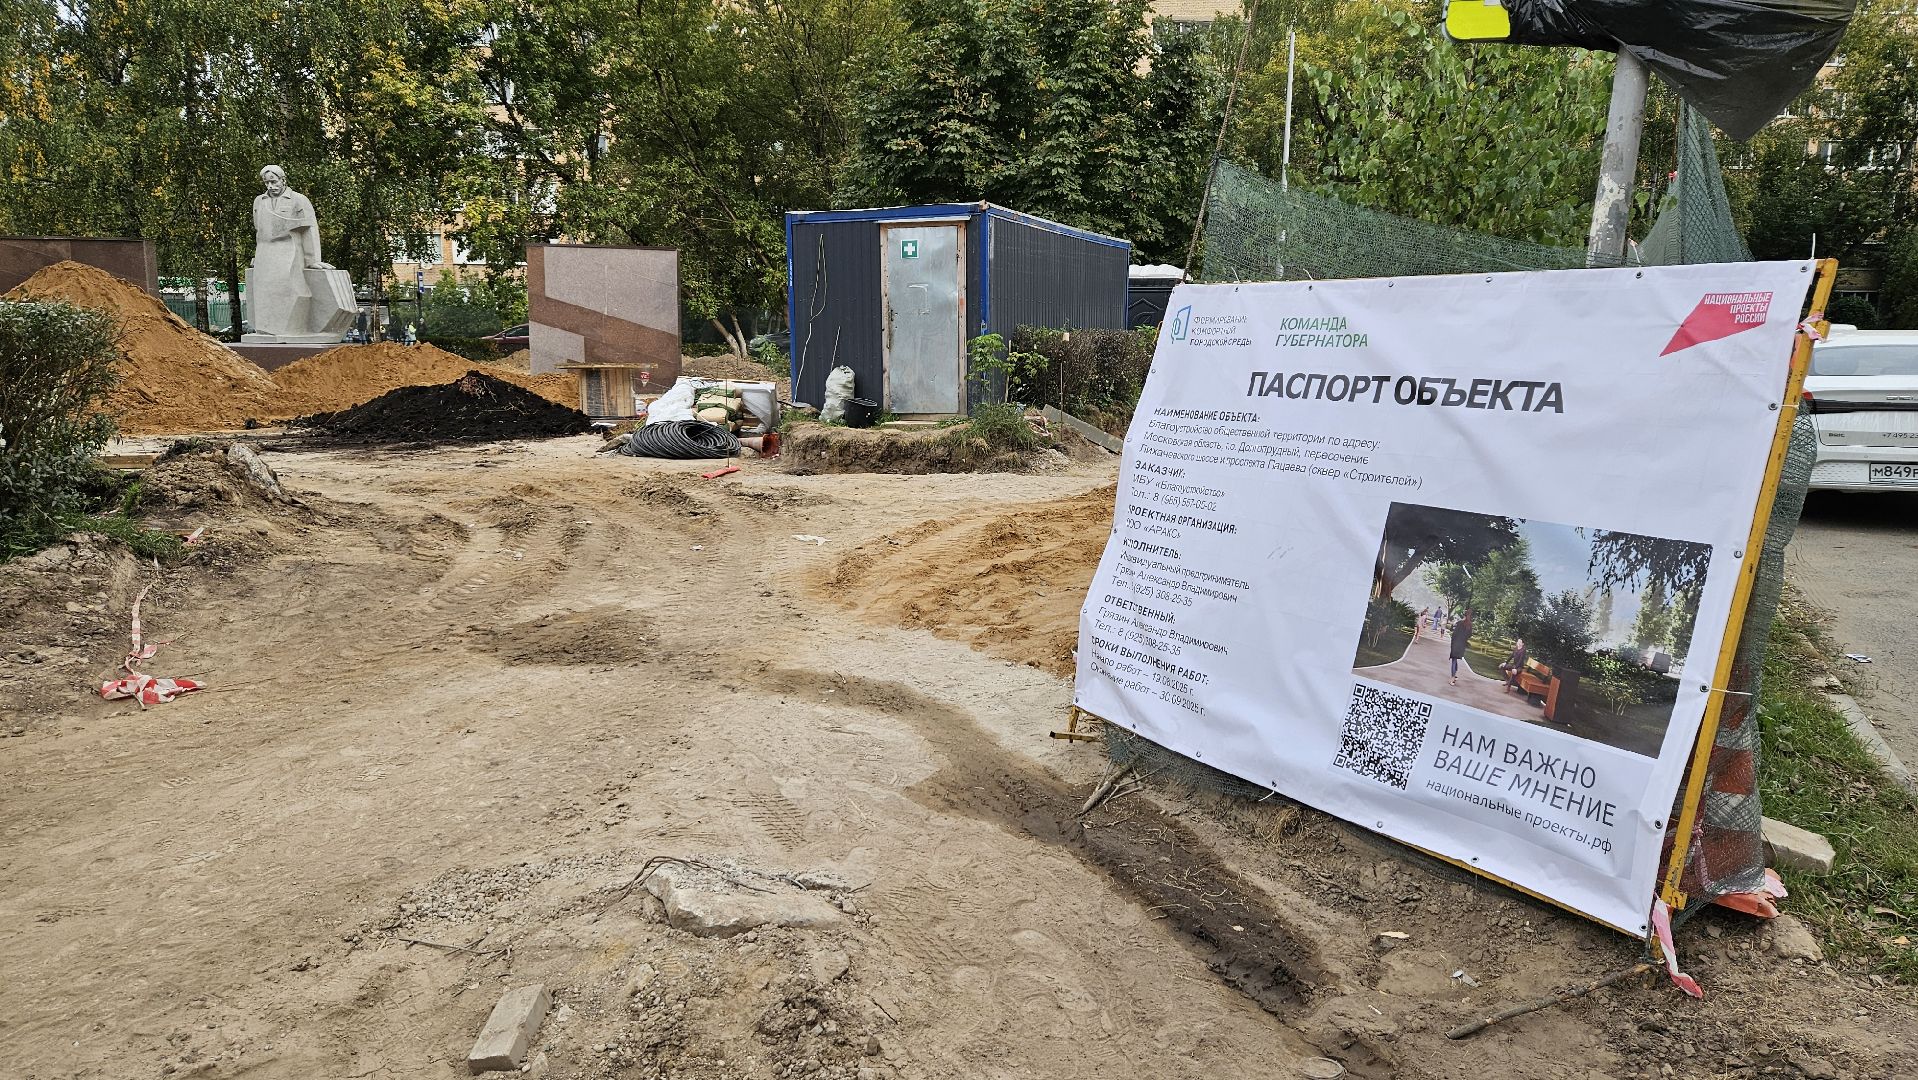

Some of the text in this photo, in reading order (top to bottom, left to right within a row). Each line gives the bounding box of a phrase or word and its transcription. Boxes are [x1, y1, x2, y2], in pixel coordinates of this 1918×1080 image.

[1704, 292, 1772, 305] НАЦИОНАЛЬНЫЕ
[1730, 303, 1768, 314] ПРОЕКТЫ
[1279, 316, 1347, 332] КОМАНДА
[1734, 313, 1765, 324] РОССИИ
[1228, 337, 1252, 347] СРЕДЫ
[1275, 333, 1368, 348] ГУБЕРНАТОРА
[1246, 371, 1565, 413] ПАСПОРТ ОБЪЕКТА
[1153, 407, 1261, 423] НАИМЕНОВАНИЕ ОБЪЕКТА:
[1213, 425, 1271, 439] общественной
[1273, 431, 1326, 445] территории
[1327, 436, 1341, 446] по
[1342, 438, 1381, 452] адресу:
[1304, 448, 1369, 465] пересечение
[1308, 463, 1341, 480] (сквер
[1343, 467, 1423, 491] «Строителей»)
[1178, 515, 1238, 535] ОРГАНИЗАЦИЯ:
[1098, 606, 1130, 625] Грязин
[1094, 619, 1117, 634] Тел.:
[1115, 661, 1142, 677] работ
[1120, 646, 1176, 673] ВЫПОЛНЕНИЯ
[1177, 666, 1209, 685] РАБОТ:
[1123, 678, 1151, 695] работ
[1441, 724, 1596, 789] НАМ ВАЖНО
[1433, 750, 1617, 828] ВАШЕ МНЕНИЕ
[1425, 779, 1613, 855] национальные проекты.рф
